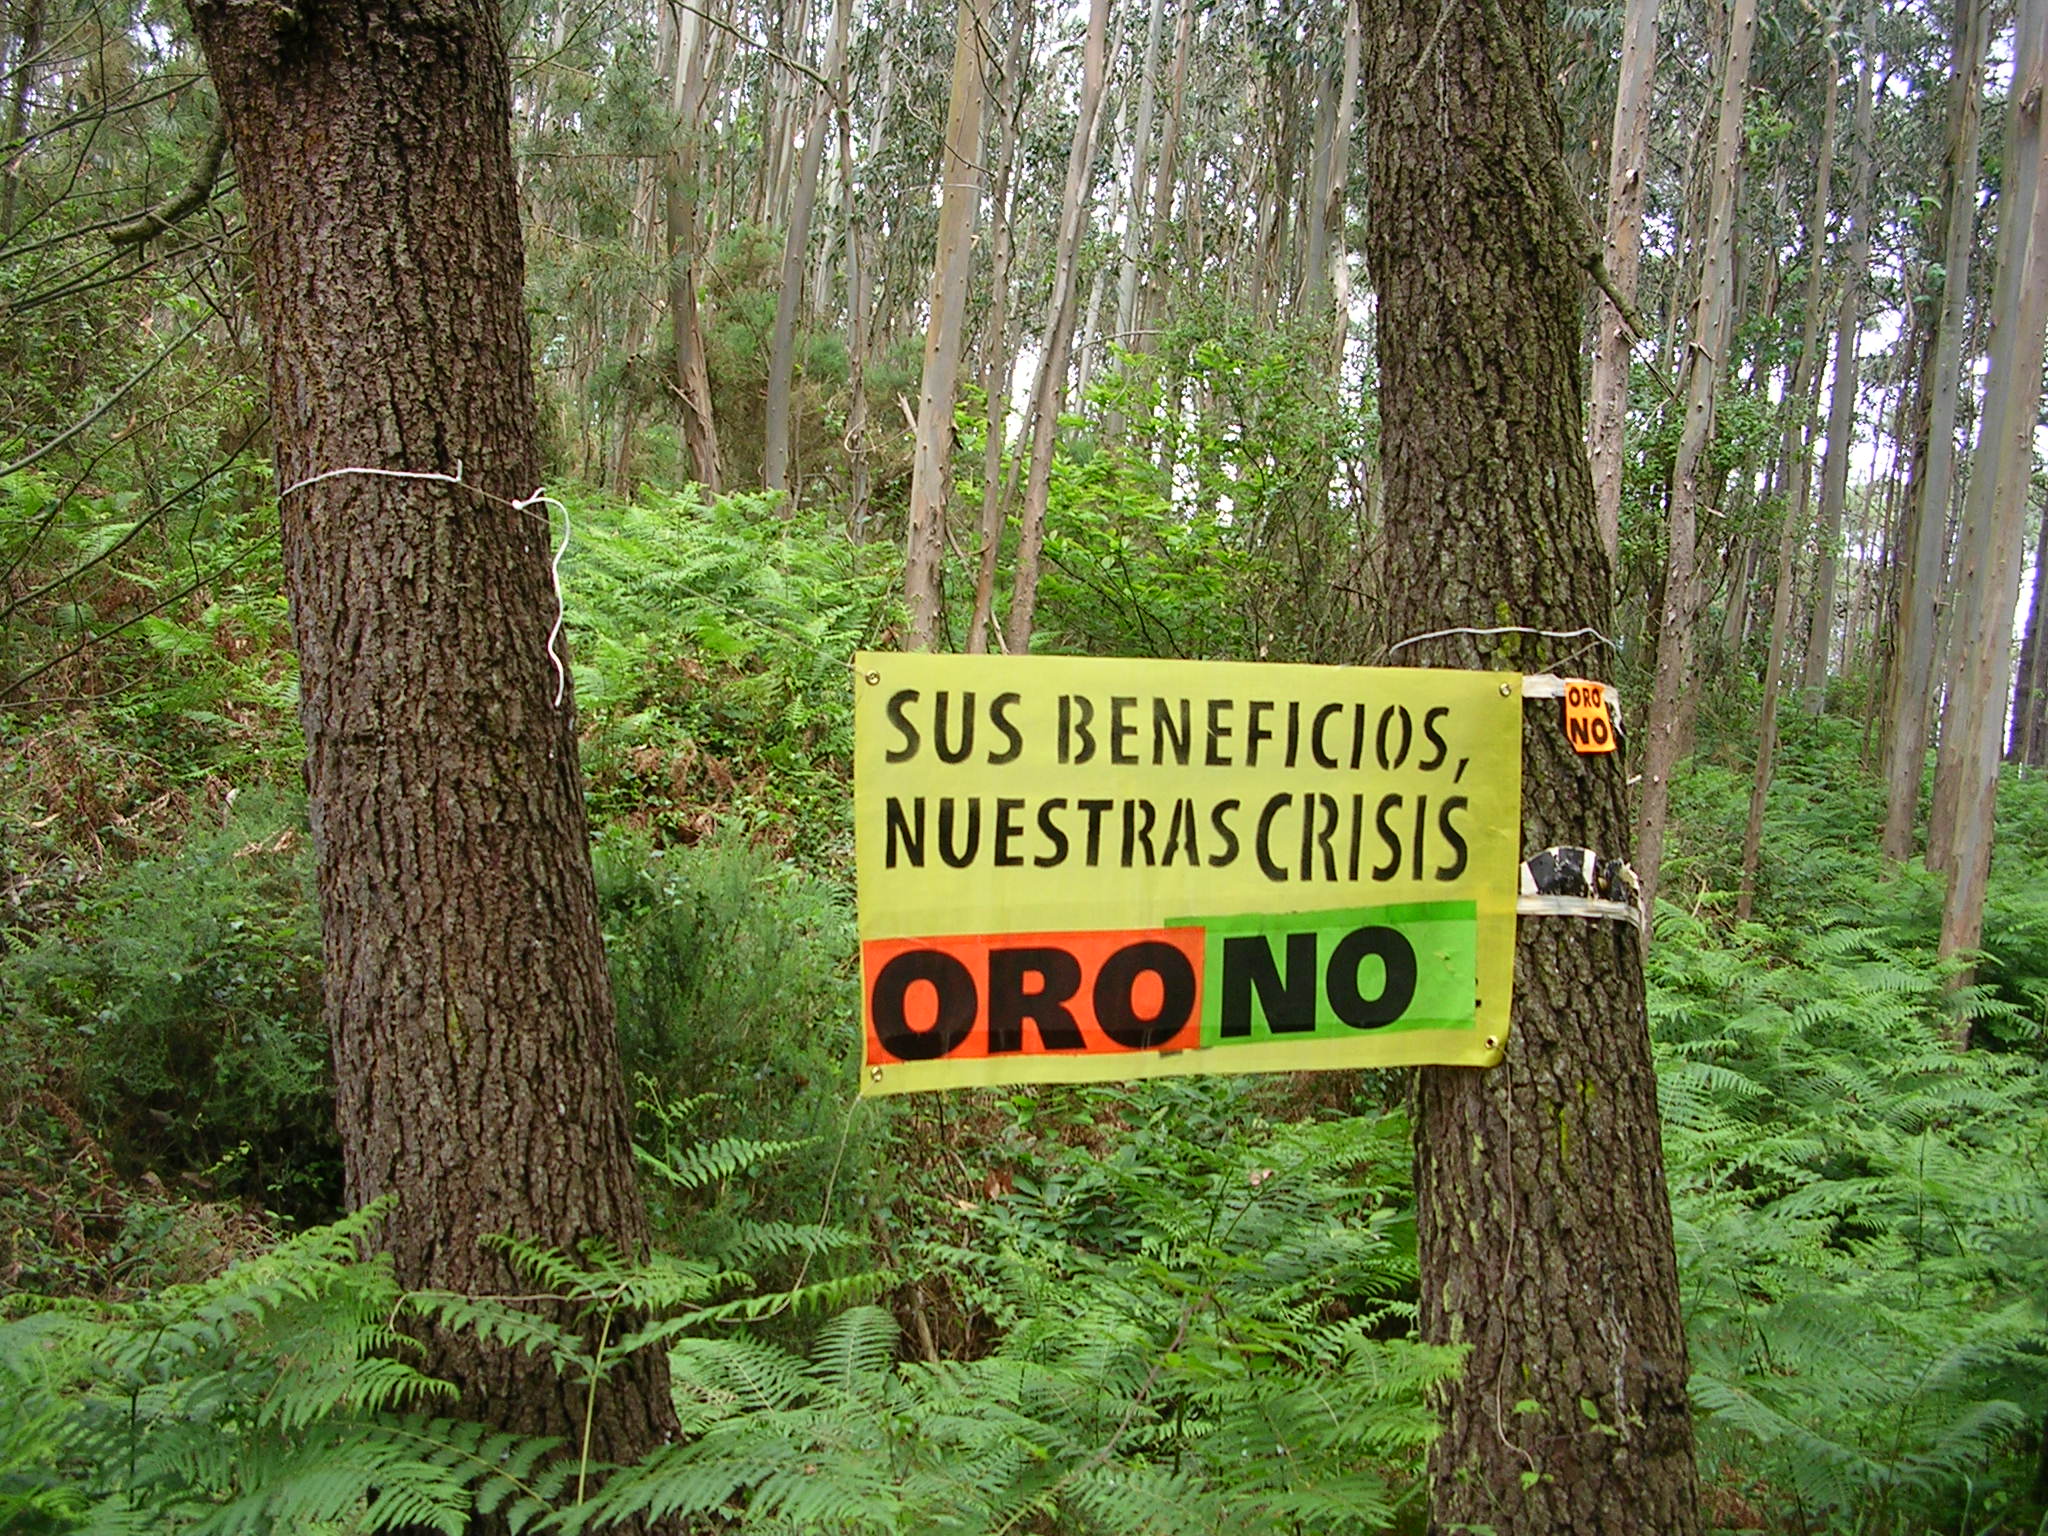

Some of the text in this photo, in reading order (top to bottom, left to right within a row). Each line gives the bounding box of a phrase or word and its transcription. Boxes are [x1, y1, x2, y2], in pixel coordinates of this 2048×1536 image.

[885, 689, 1470, 784] SUS BENEFICIOS,
[1569, 686, 1601, 708] ORO
[1571, 717, 1608, 745] NO
[885, 792, 1469, 882] NUESTRAS CRISIS
[870, 926, 1417, 1061] ORO NO
